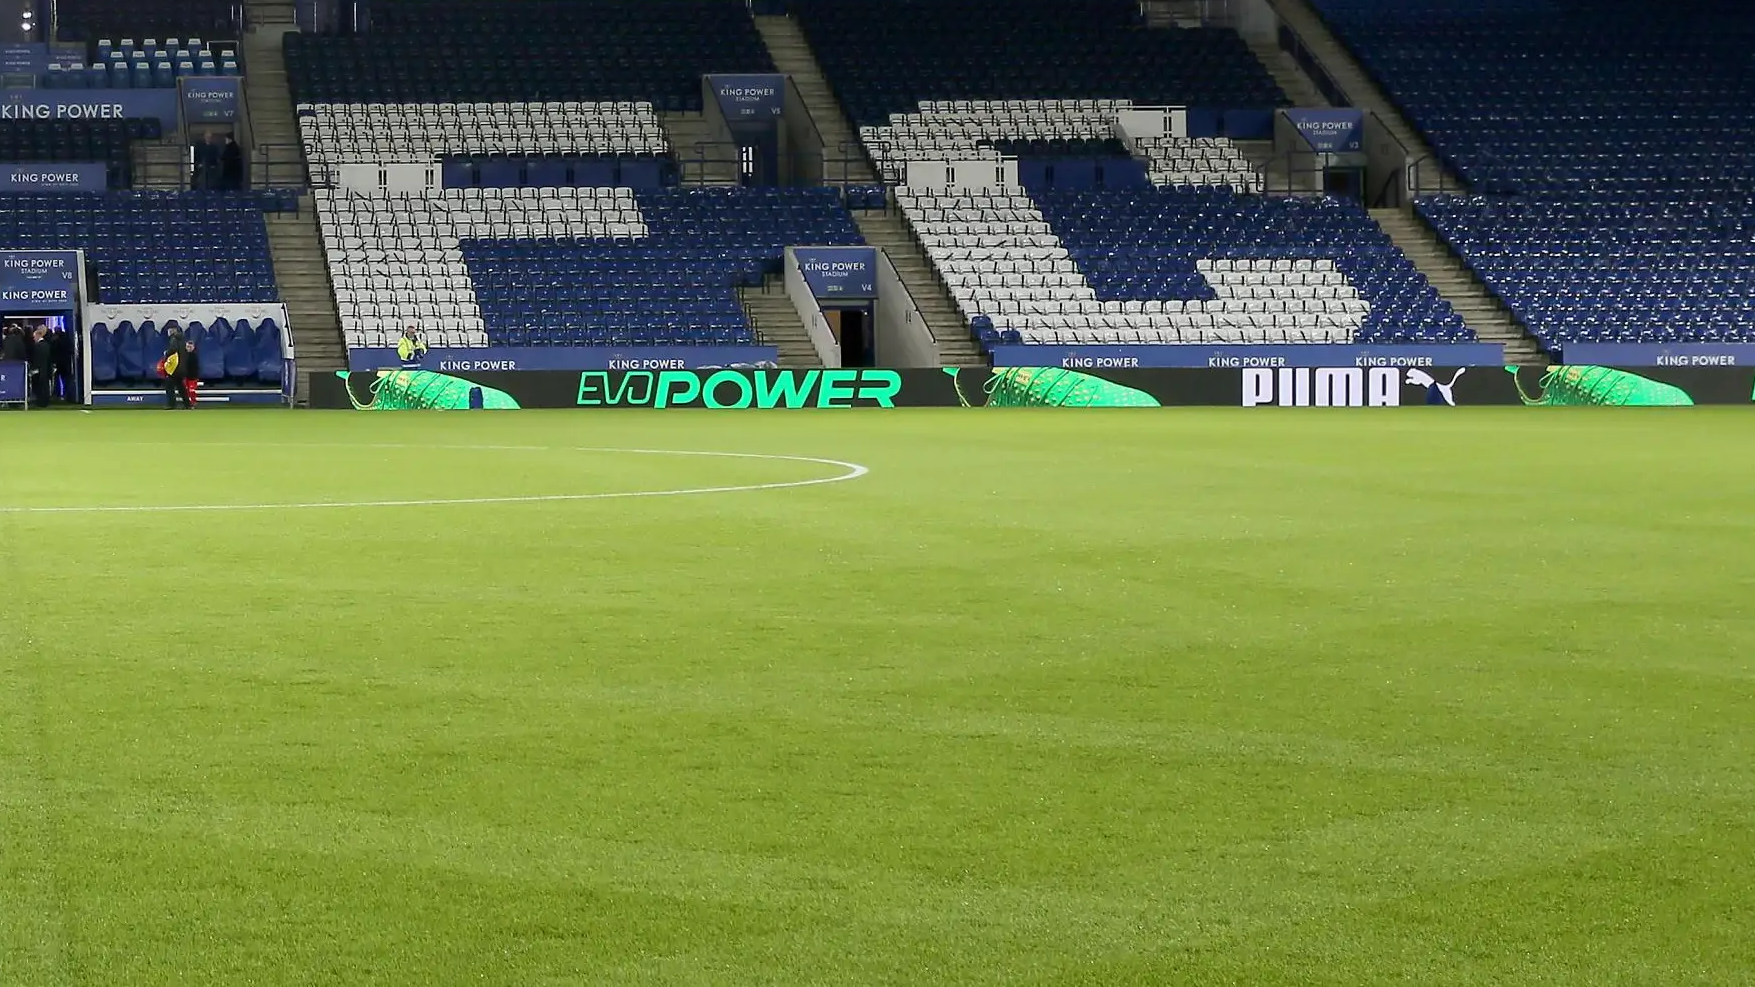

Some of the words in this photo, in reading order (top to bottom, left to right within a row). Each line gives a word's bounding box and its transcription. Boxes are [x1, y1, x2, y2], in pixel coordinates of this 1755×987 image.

[720, 88, 743, 96] KING
[744, 88, 775, 96] POWER
[1, 104, 50, 119] KING
[57, 104, 123, 119] POWER
[1296, 121, 1320, 130] KING
[1321, 121, 1353, 130] POWER
[10, 173, 39, 183] KING
[41, 173, 79, 183] POWER
[4, 259, 29, 268] KING
[31, 259, 64, 268] POWER
[805, 262, 829, 271] KING
[832, 262, 865, 271] POWER
[861, 283, 872, 292] V4
[2, 291, 28, 300] KING
[31, 290, 67, 300] POWER
[440, 360, 471, 371] KING
[474, 360, 516, 371] POWER
[608, 359, 640, 370] KING
[643, 359, 685, 370] POWER
[1062, 357, 1093, 368] KING
[1096, 357, 1139, 368] POWER
[1208, 357, 1239, 367] KING
[1243, 357, 1286, 367] POWER
[1355, 356, 1387, 367] KING
[1390, 356, 1433, 367] POWER
[1656, 355, 1689, 366] KING
[1692, 355, 1735, 366] POWER
[576, 369, 902, 408] EVOPOWER
[1242, 367, 1400, 407] PUMA
